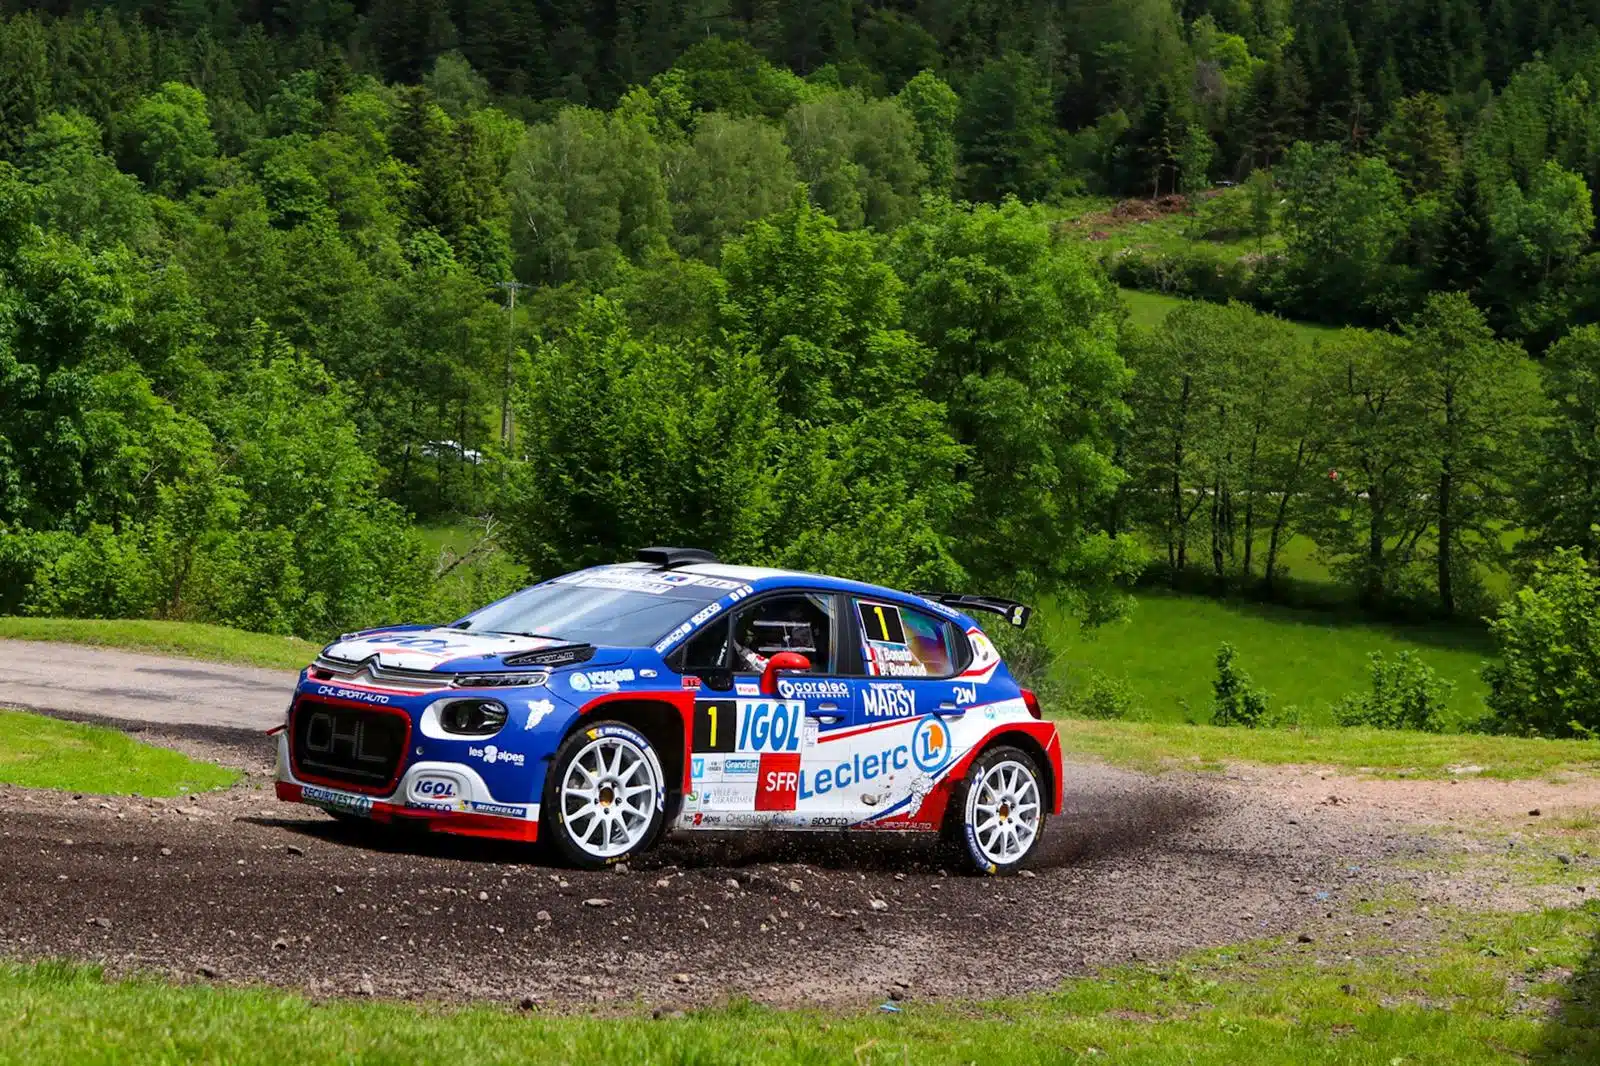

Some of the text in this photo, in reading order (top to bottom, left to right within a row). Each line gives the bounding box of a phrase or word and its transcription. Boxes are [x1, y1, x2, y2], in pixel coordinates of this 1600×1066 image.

[873, 606, 890, 640] 1
[318, 686, 389, 703] CHL SPORT AUTO
[794, 680, 848, 693] corelec
[862, 690, 915, 716] MARSY
[707, 706, 718, 747] 1
[738, 703, 800, 751] IGOL
[306, 712, 388, 763] CHL
[469, 746, 483, 757] les
[498, 750, 525, 762] alpes
[765, 772, 797, 792] SFR
[799, 744, 908, 800] Leclerc
[475, 803, 524, 815] MICHELIN
[684, 814, 693, 822] les
[702, 815, 720, 824] alpes
[811, 817, 848, 826] sparco
